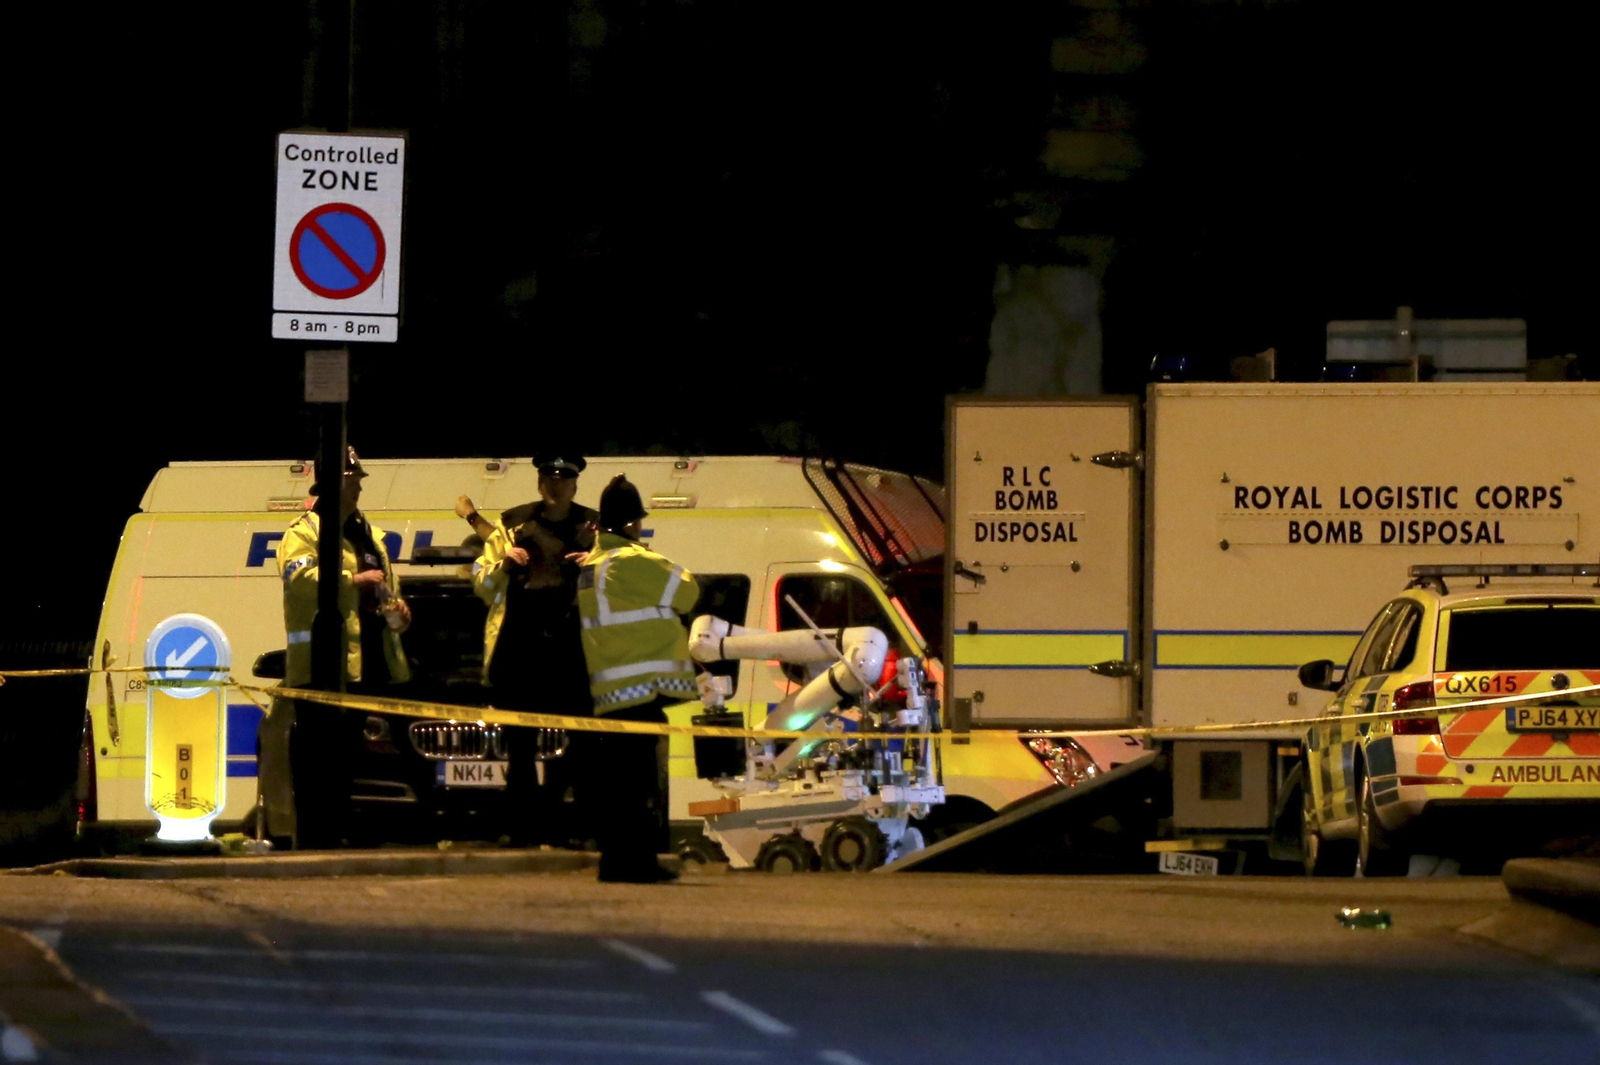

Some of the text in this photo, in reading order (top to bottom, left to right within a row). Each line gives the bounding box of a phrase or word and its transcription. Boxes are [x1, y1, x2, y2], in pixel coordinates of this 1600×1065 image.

[284, 144, 398, 165] Controlled
[302, 169, 378, 191] ZONE
[290, 319, 299, 331] 8
[305, 322, 328, 332] am
[995, 490, 1058, 511] BOMB
[1234, 486, 1563, 510] ROYAL LOGISTIC CORPS
[975, 521, 1078, 543] DISPOSAL
[1289, 520, 1505, 544] BOMB DISPOSAL
[1445, 676, 1517, 694] QX615
[1518, 709, 1600, 727] PJ64 XY
[452, 764, 494, 781] NK14
